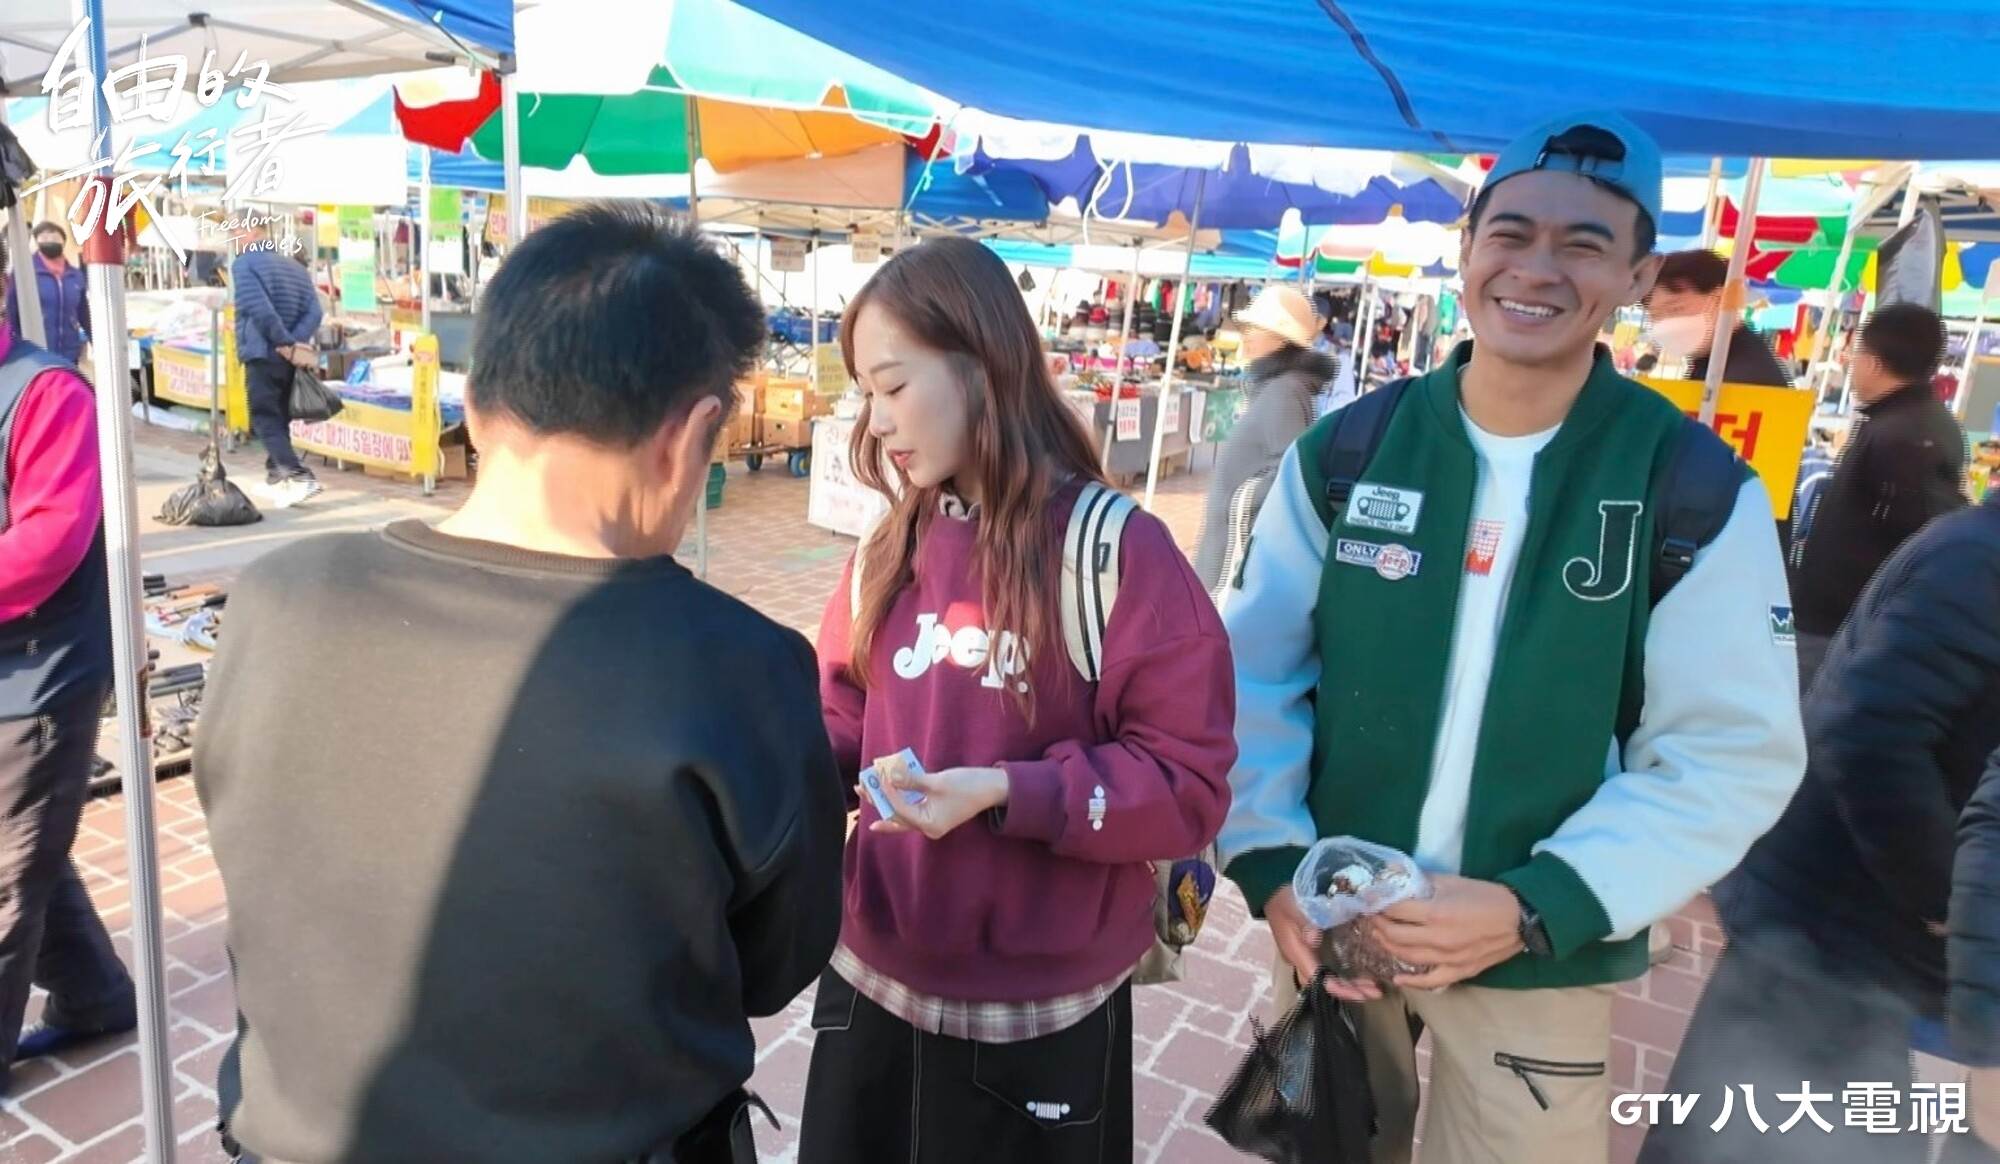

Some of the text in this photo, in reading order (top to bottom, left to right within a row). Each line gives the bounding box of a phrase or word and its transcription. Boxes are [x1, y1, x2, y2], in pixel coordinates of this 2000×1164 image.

[1372, 486, 1400, 501] Jeep
[1344, 543, 1378, 557] ONLY
[1562, 500, 1644, 601] J
